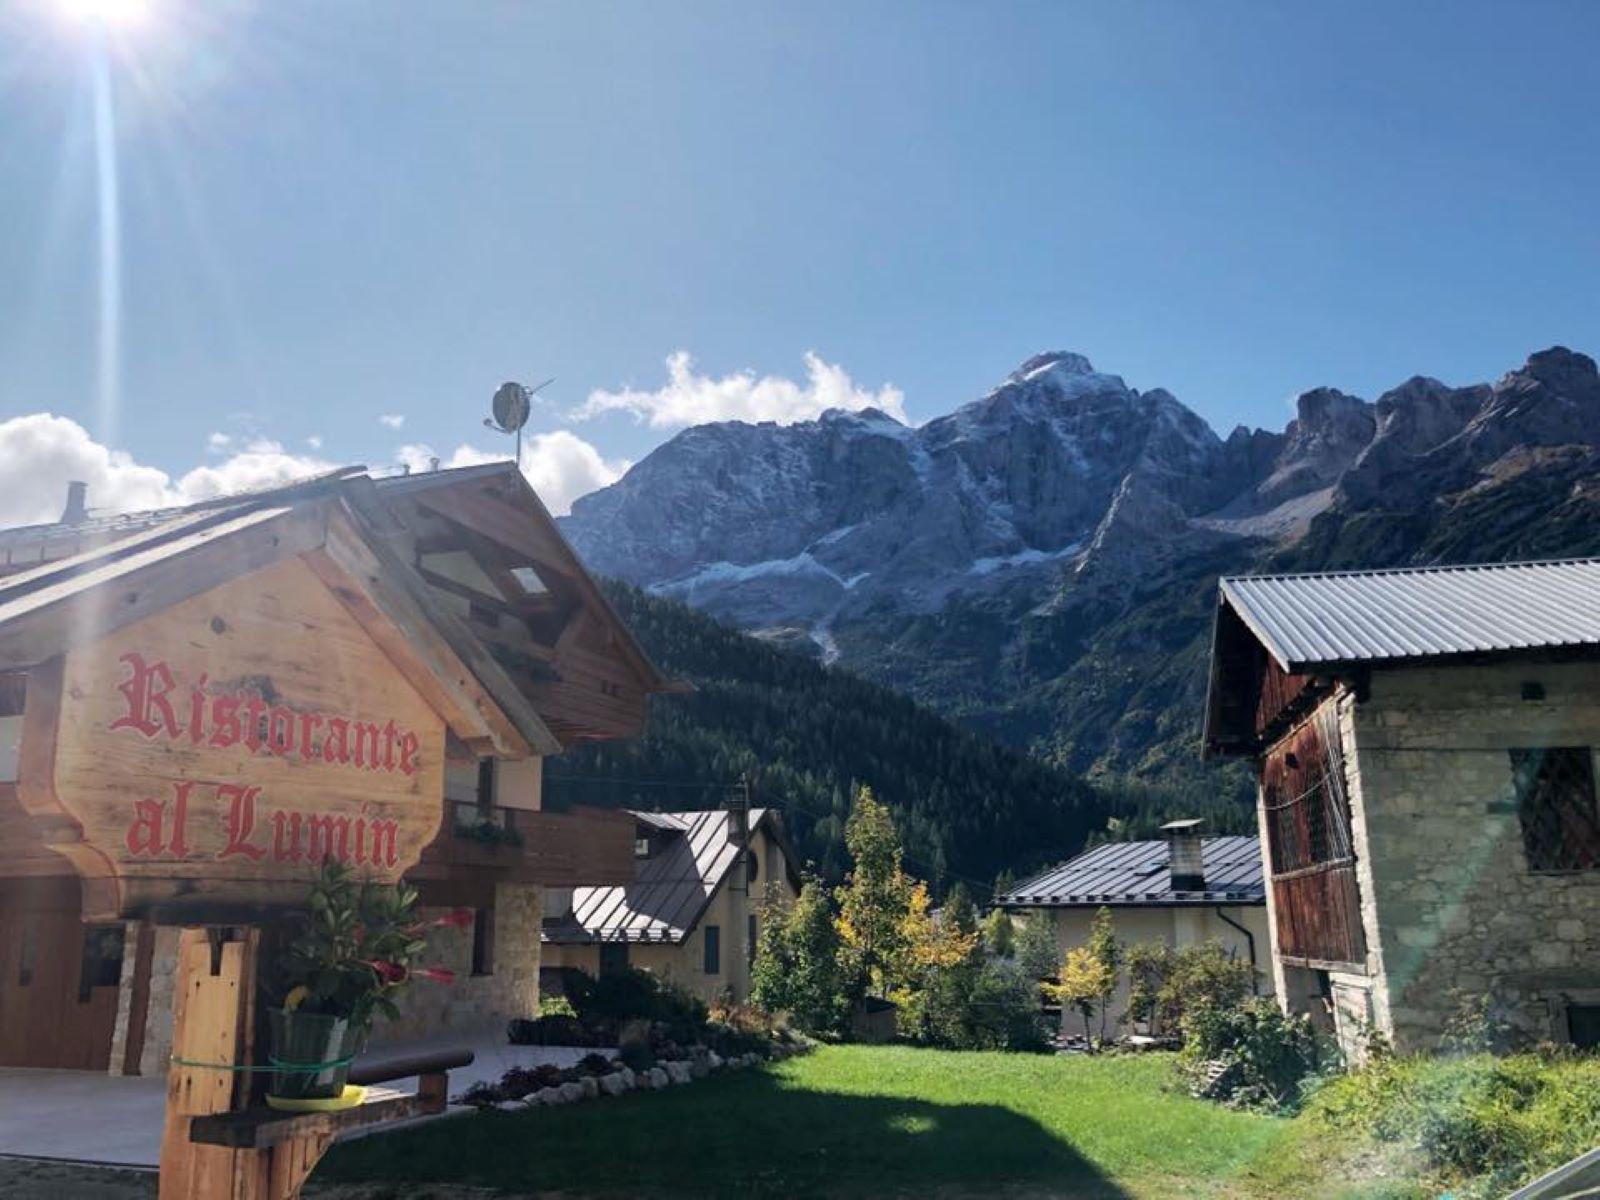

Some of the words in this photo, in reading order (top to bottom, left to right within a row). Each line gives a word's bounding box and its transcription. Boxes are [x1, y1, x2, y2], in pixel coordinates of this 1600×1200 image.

[109, 652, 420, 775] Ristorante
[126, 780, 191, 859] al
[215, 783, 399, 869] Lumin
